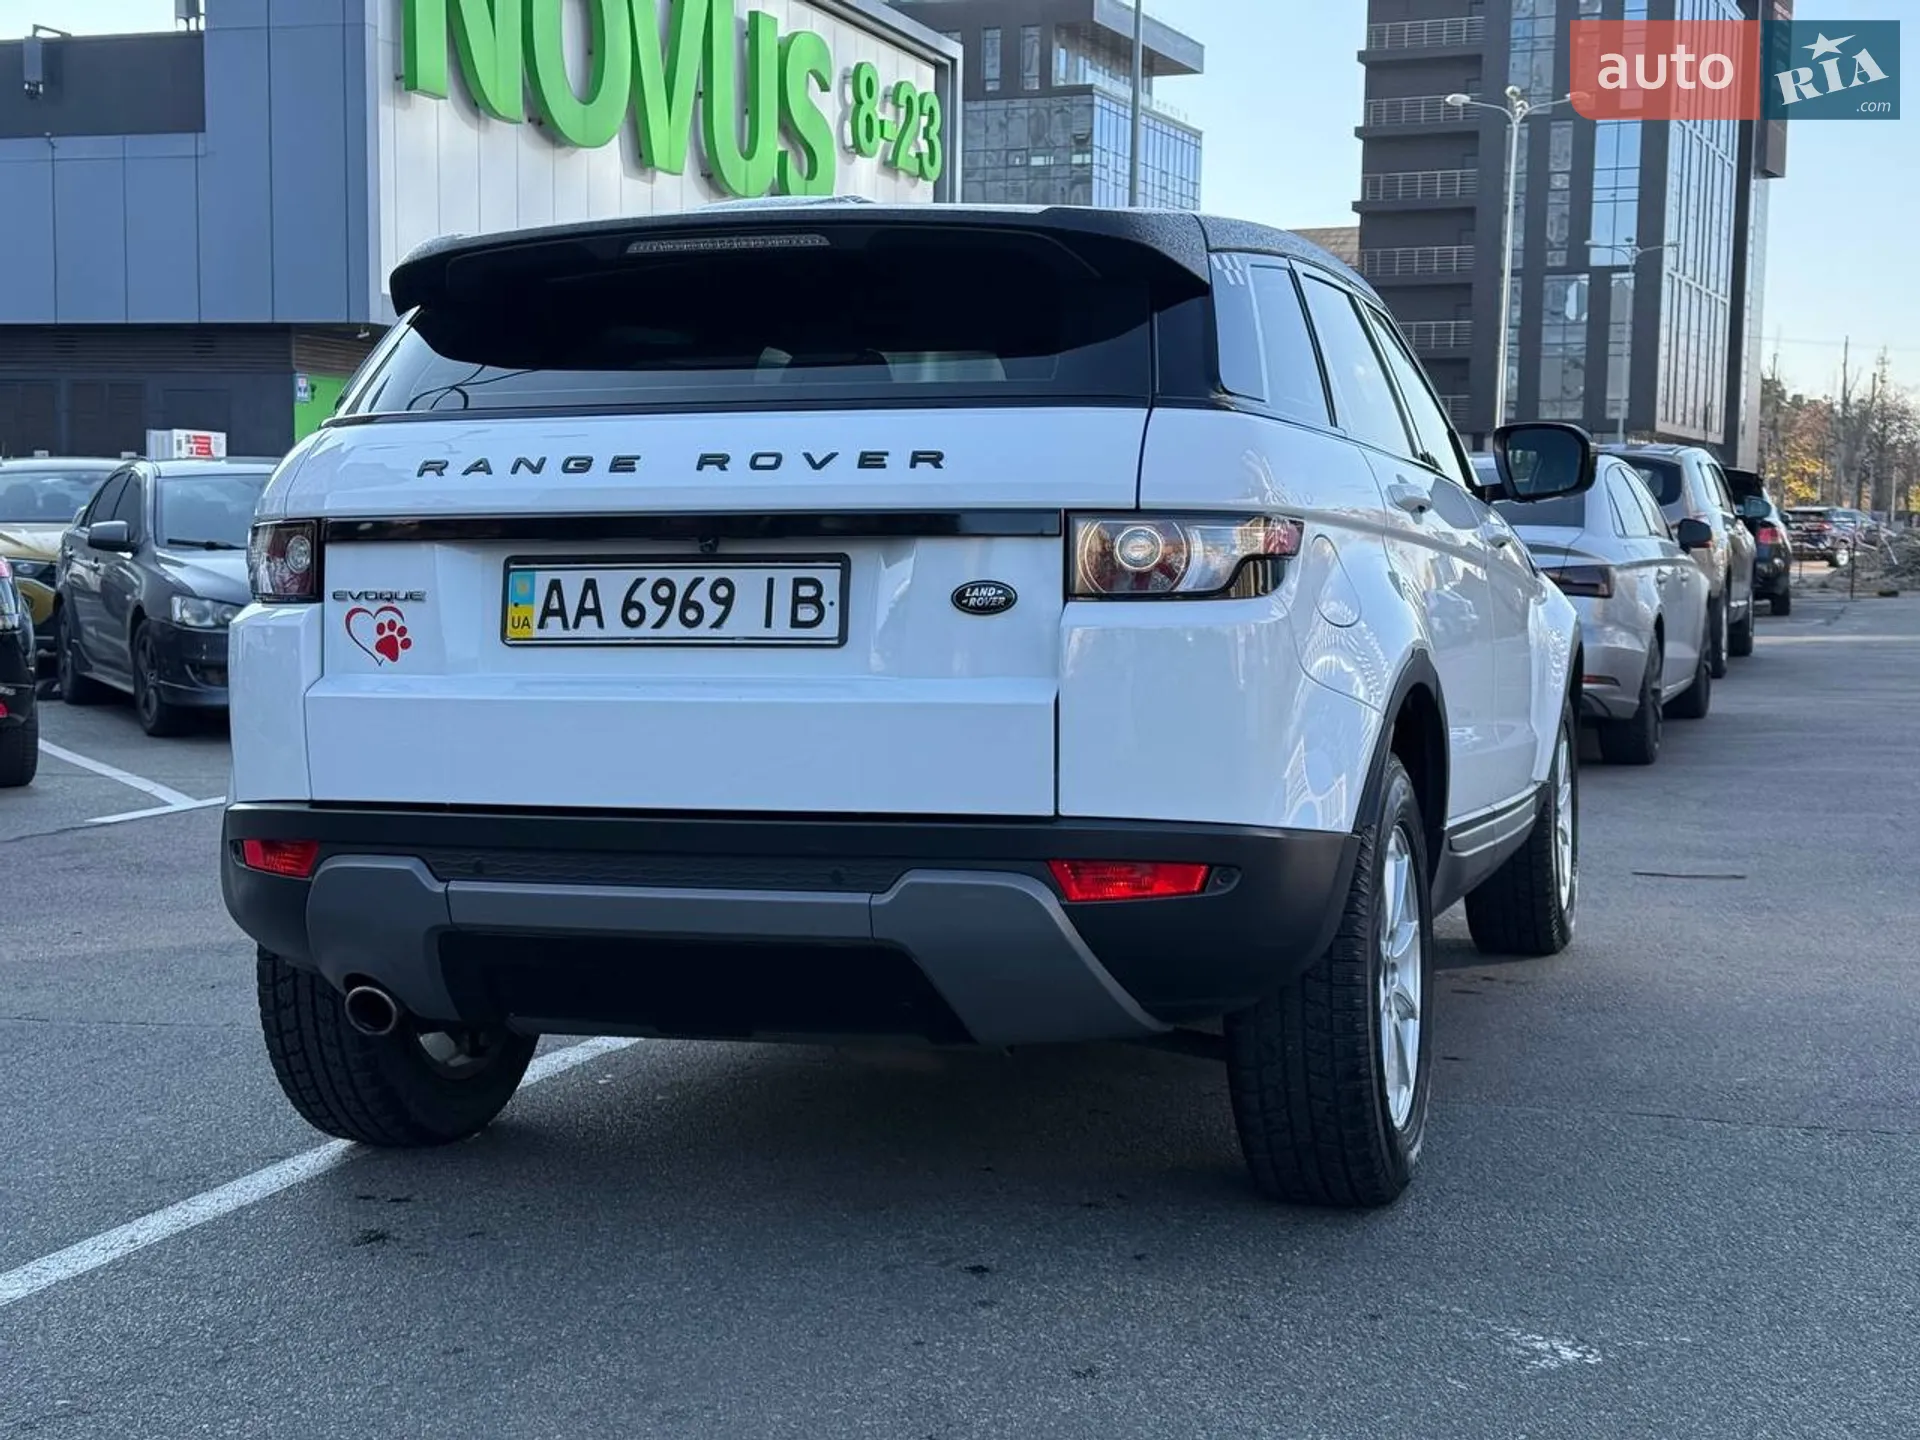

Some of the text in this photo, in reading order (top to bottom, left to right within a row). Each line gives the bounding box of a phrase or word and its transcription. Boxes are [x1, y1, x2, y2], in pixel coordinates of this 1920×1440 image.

[851, 61, 943, 181] 8-23
[417, 450, 945, 478] RANGE ROVER
[332, 590, 426, 603] EVOQUE
[511, 577, 826, 630] UA AA 6969 IB
